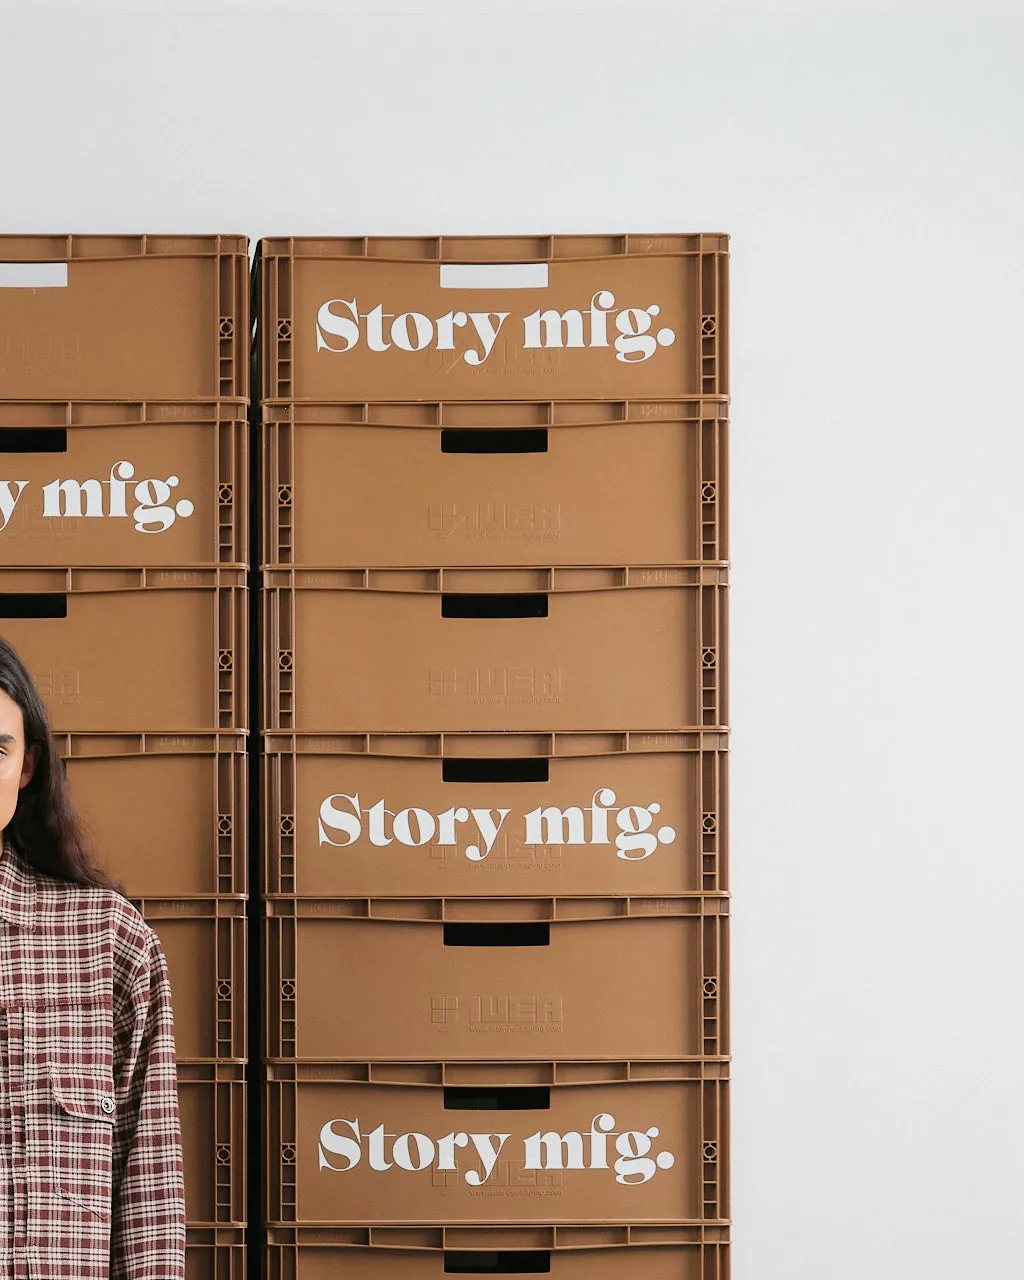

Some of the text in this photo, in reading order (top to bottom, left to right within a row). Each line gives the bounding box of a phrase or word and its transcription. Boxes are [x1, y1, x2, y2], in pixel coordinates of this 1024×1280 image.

[316, 299, 510, 365] Story
[523, 291, 675, 362] mfg.
[43, 461, 194, 533] mfg.
[318, 793, 511, 861] Story
[524, 788, 676, 860] mfg.
[318, 1113, 674, 1185] Story mfg.
